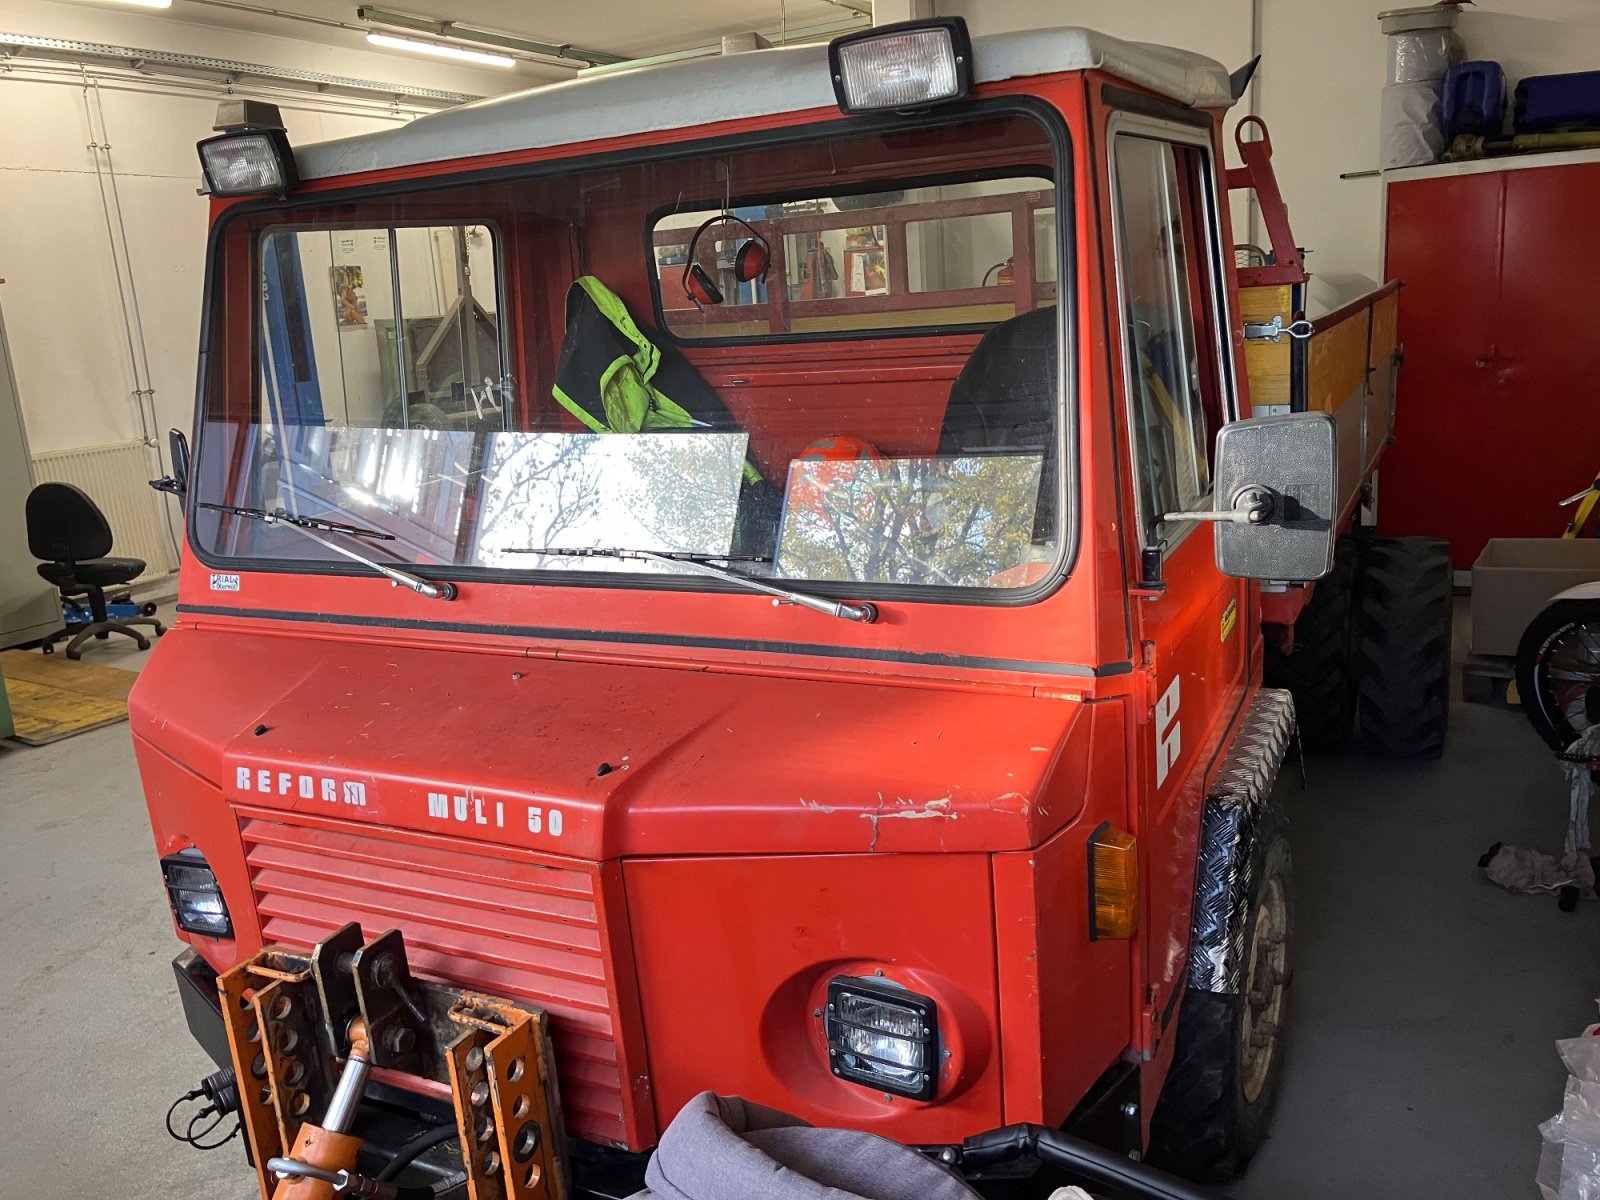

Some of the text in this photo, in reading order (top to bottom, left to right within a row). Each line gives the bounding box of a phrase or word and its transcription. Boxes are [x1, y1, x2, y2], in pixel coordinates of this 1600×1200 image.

[236, 766, 563, 837] REFORM MULI 50
